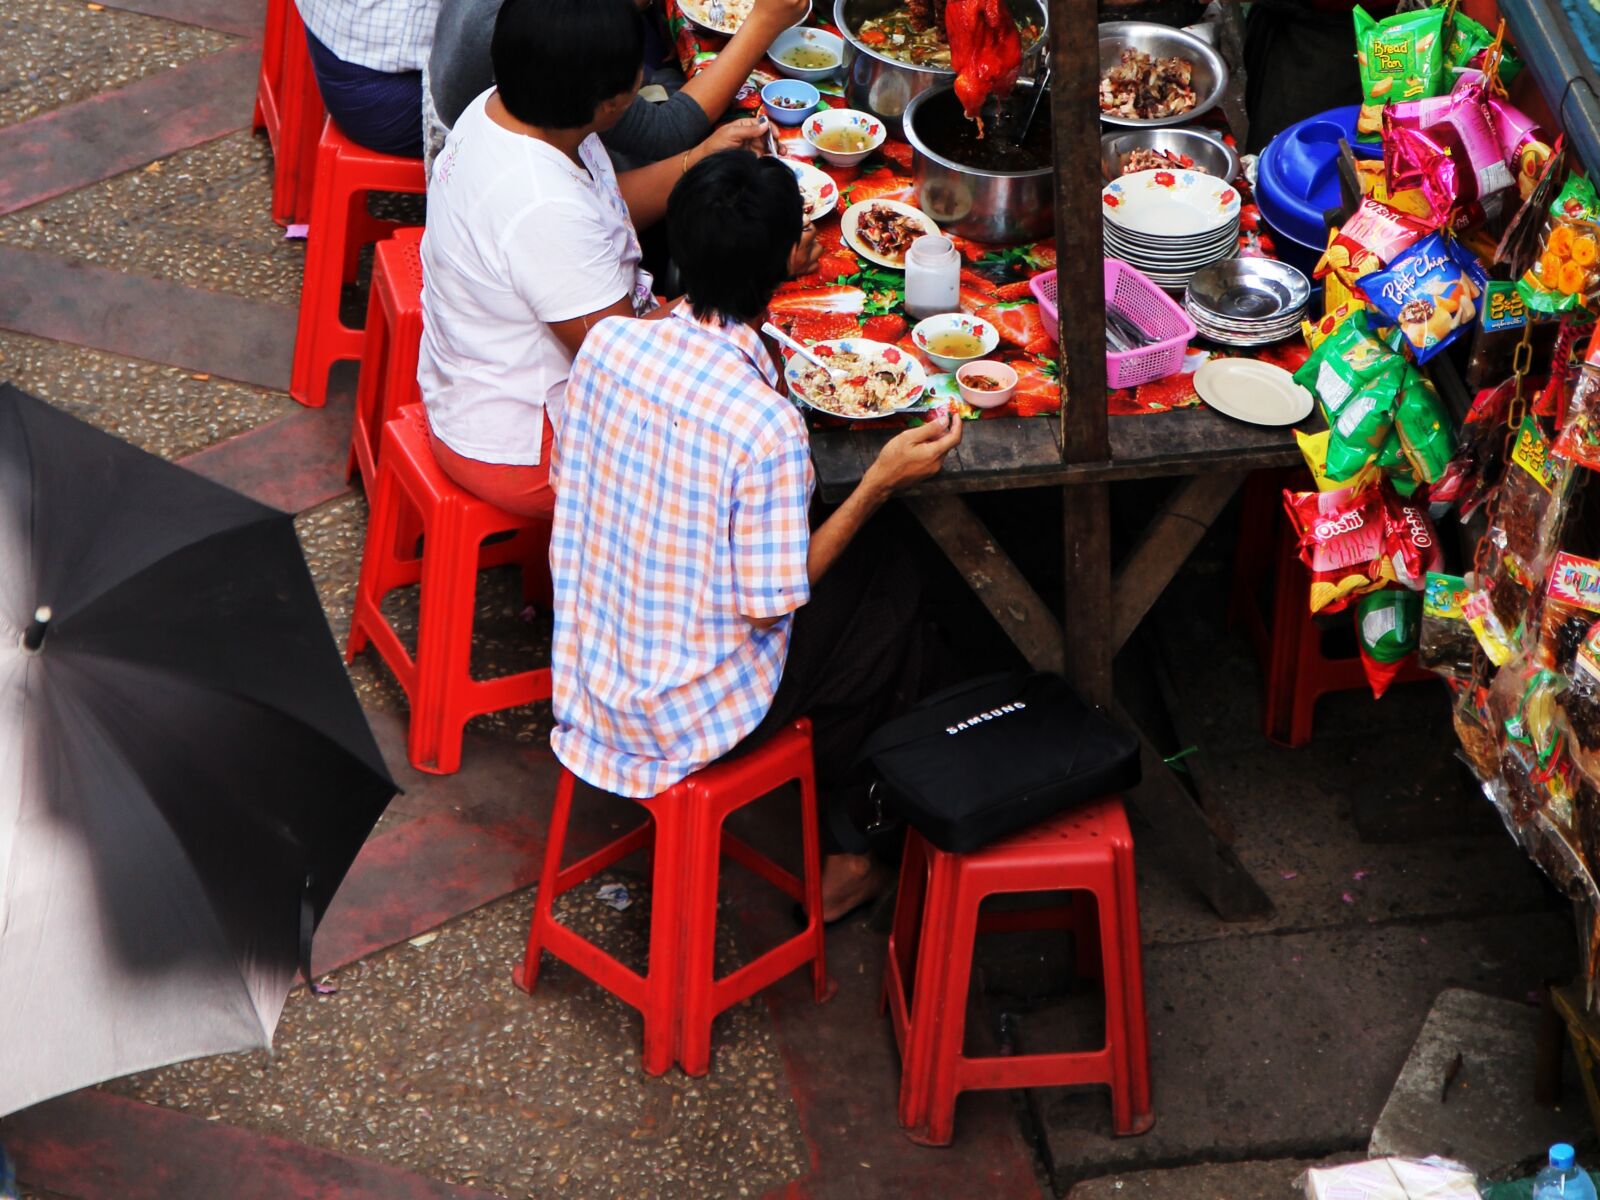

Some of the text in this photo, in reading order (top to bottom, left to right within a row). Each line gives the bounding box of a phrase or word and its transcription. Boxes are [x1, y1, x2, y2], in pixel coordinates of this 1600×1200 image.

[1374, 40, 1408, 56] Bread
[1382, 272, 1417, 305] Potato
[1413, 253, 1450, 278] Chips
[1315, 511, 1364, 539] Oishi
[1403, 506, 1432, 547] Oishi
[946, 702, 1026, 734] SAMSUNG
